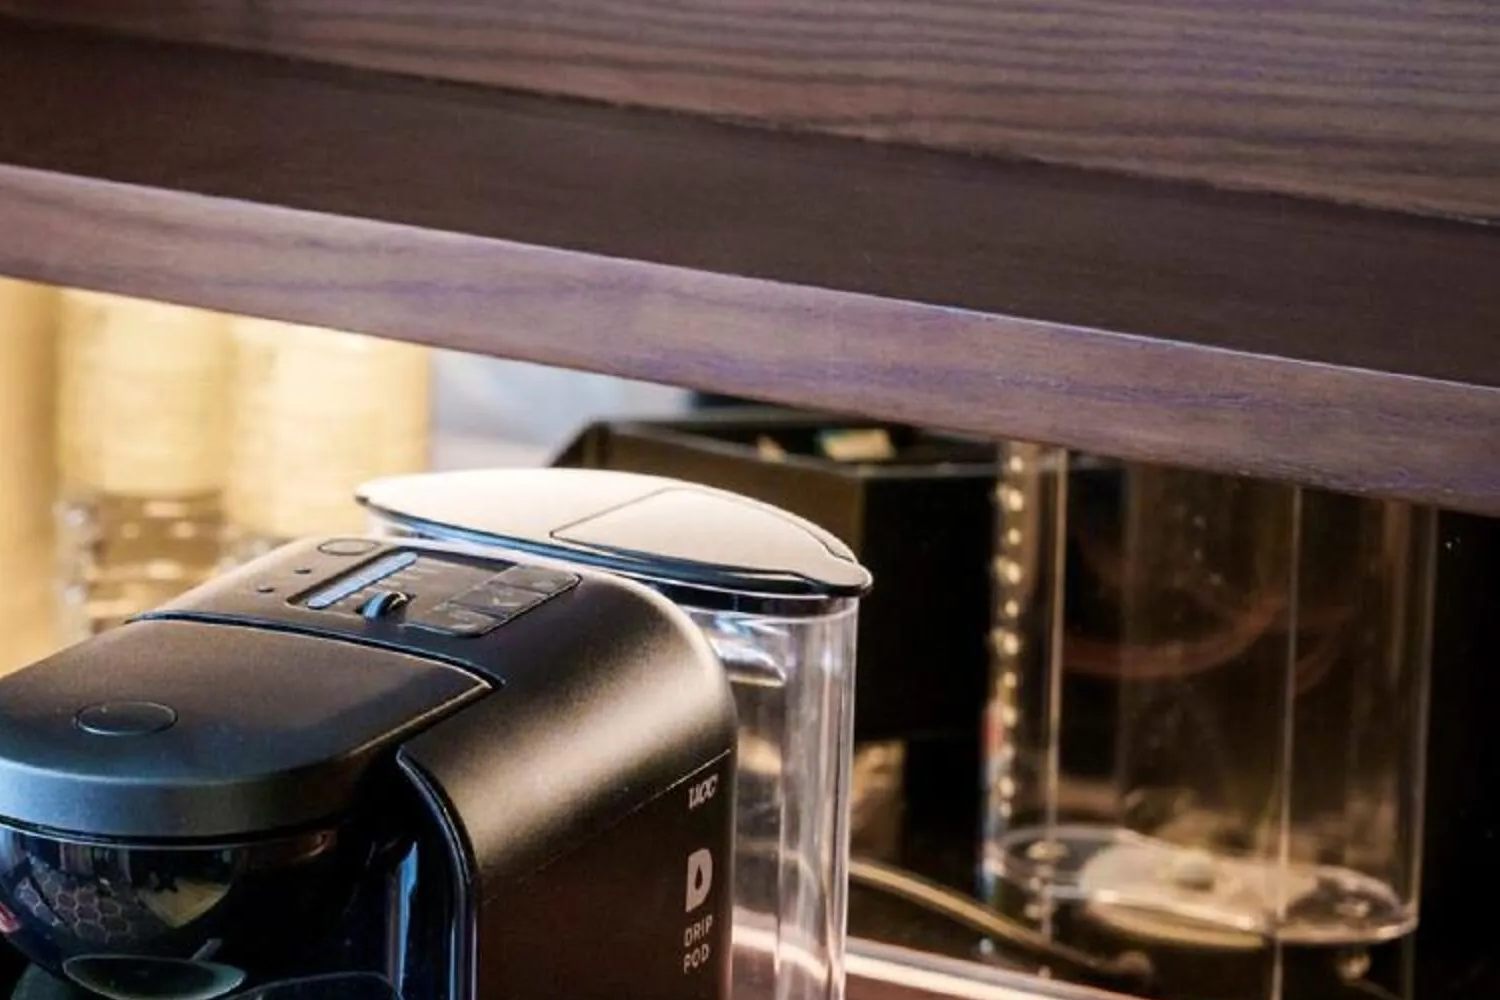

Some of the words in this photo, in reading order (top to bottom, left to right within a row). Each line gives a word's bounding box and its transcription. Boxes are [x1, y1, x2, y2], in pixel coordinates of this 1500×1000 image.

[685, 848, 713, 912] D
[684, 914, 713, 947] DRIP
[683, 943, 710, 974] POD
